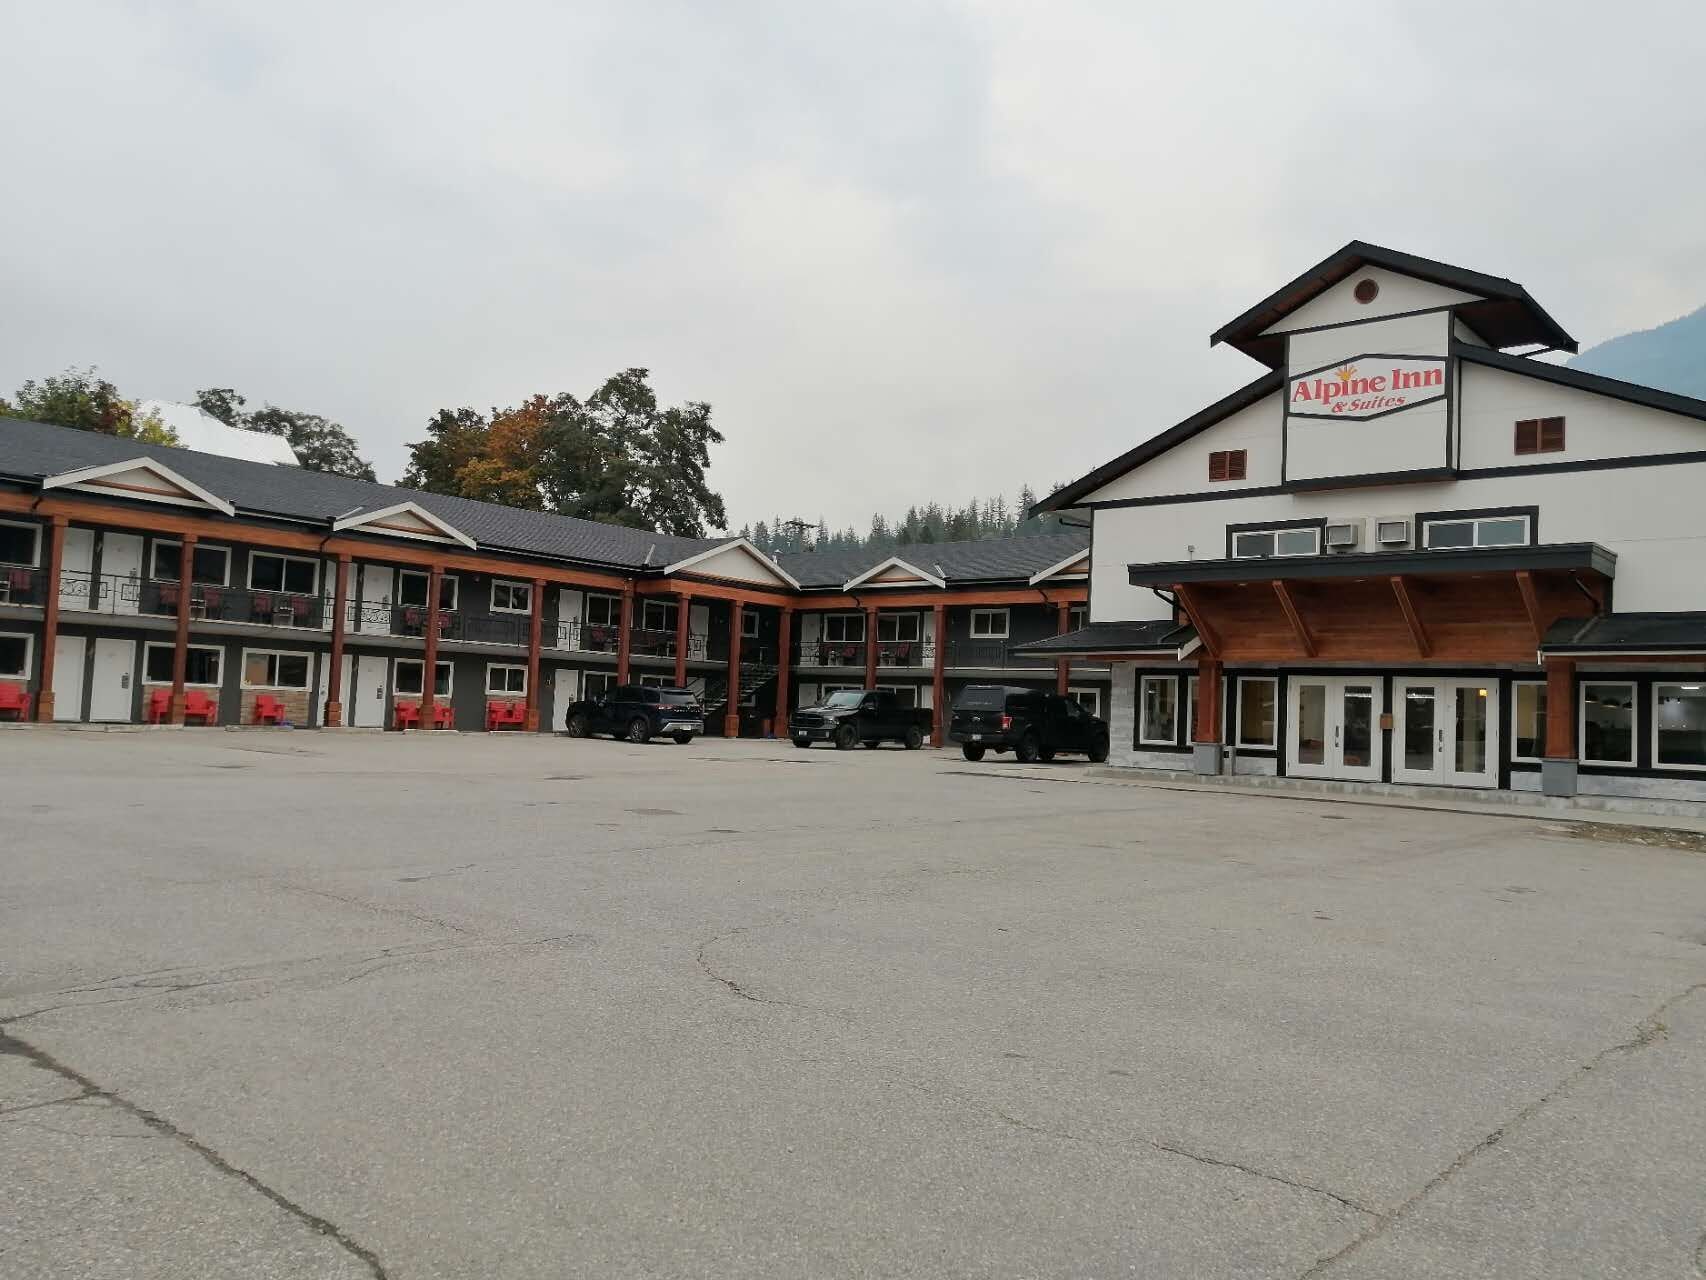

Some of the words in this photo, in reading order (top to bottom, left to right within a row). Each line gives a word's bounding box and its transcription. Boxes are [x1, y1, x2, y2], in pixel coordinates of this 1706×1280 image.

[1292, 375, 1386, 405] Alpine
[1392, 367, 1443, 390] Inn
[1332, 402, 1345, 413] &
[1350, 395, 1406, 411] Suites
